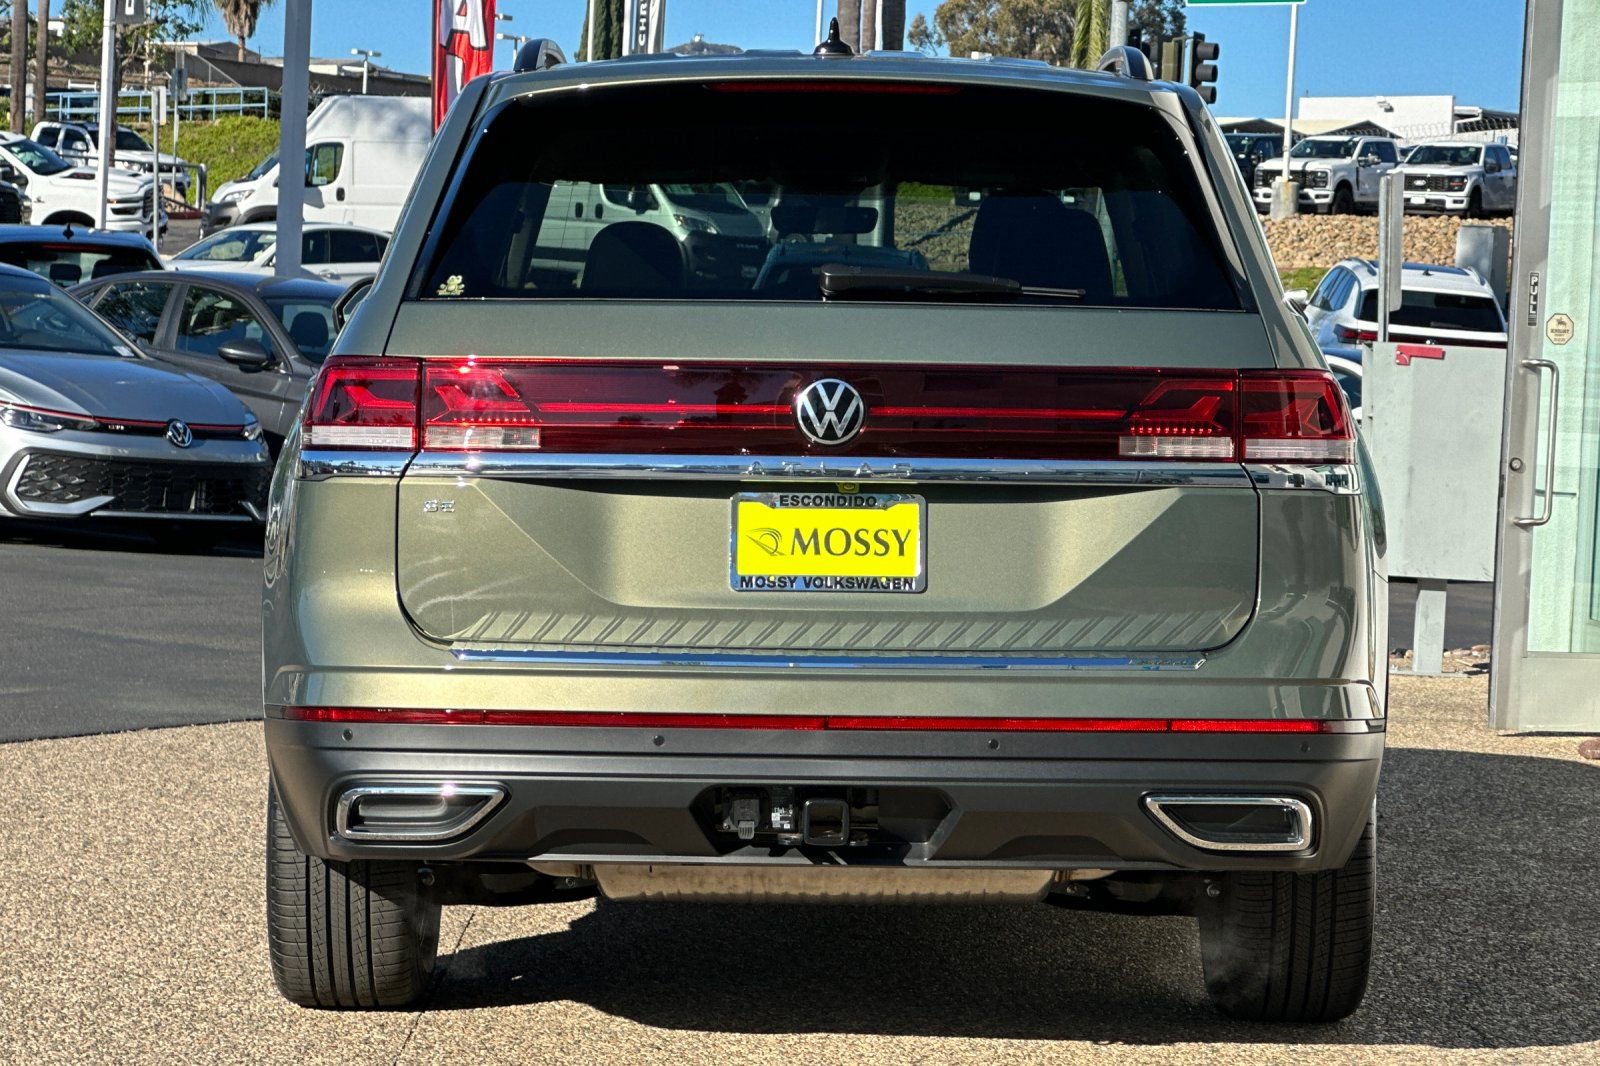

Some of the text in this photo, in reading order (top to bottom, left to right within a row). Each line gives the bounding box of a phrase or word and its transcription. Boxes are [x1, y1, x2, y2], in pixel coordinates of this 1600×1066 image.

[639, 0, 647, 46] CHR
[1529, 276, 1538, 314] PULL
[779, 494, 878, 508] ESCONDIDO
[790, 527, 912, 557] MOSSY
[740, 575, 914, 590] MOSSY VOLKSWAGEN
